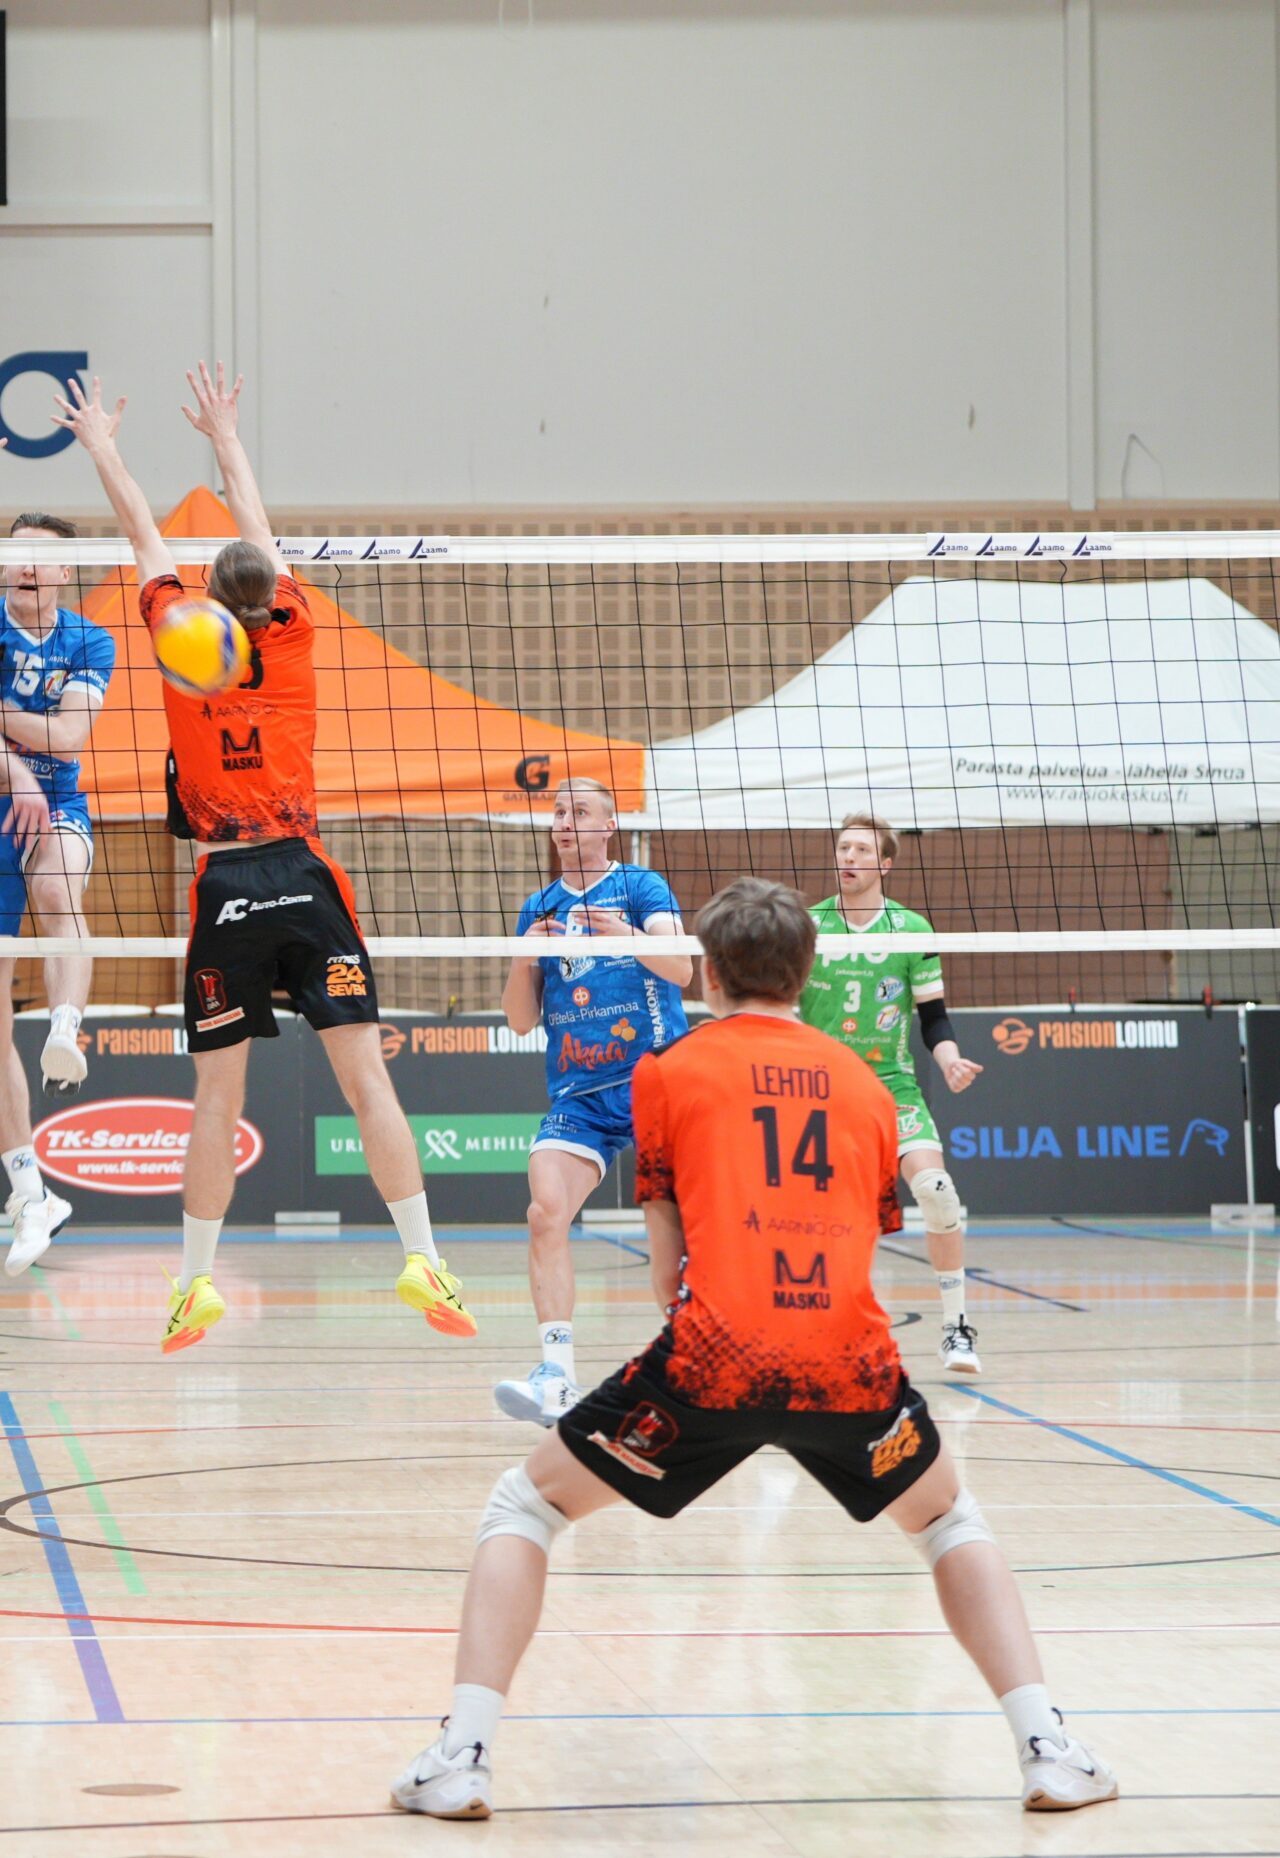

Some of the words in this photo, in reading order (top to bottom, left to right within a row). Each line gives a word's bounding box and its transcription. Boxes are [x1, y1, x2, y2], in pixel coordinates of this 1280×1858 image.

[12, 650, 46, 697] 15
[222, 756, 263, 772] MASKU
[514, 754, 551, 791] G
[956, 758, 1023, 776] Parasta
[1028, 760, 1109, 779] palvelua
[1006, 785, 1190, 803] www.raisiokeskus.fi
[215, 898, 249, 926] AC
[326, 963, 366, 984] 24
[843, 981, 862, 1013] 3
[751, 1064, 830, 1100] LEHTIÖ
[752, 1105, 834, 1192] 14
[949, 1124, 1063, 1160] SILJA
[1076, 1124, 1171, 1158] LINE
[773, 1291, 831, 1310] MASKU
